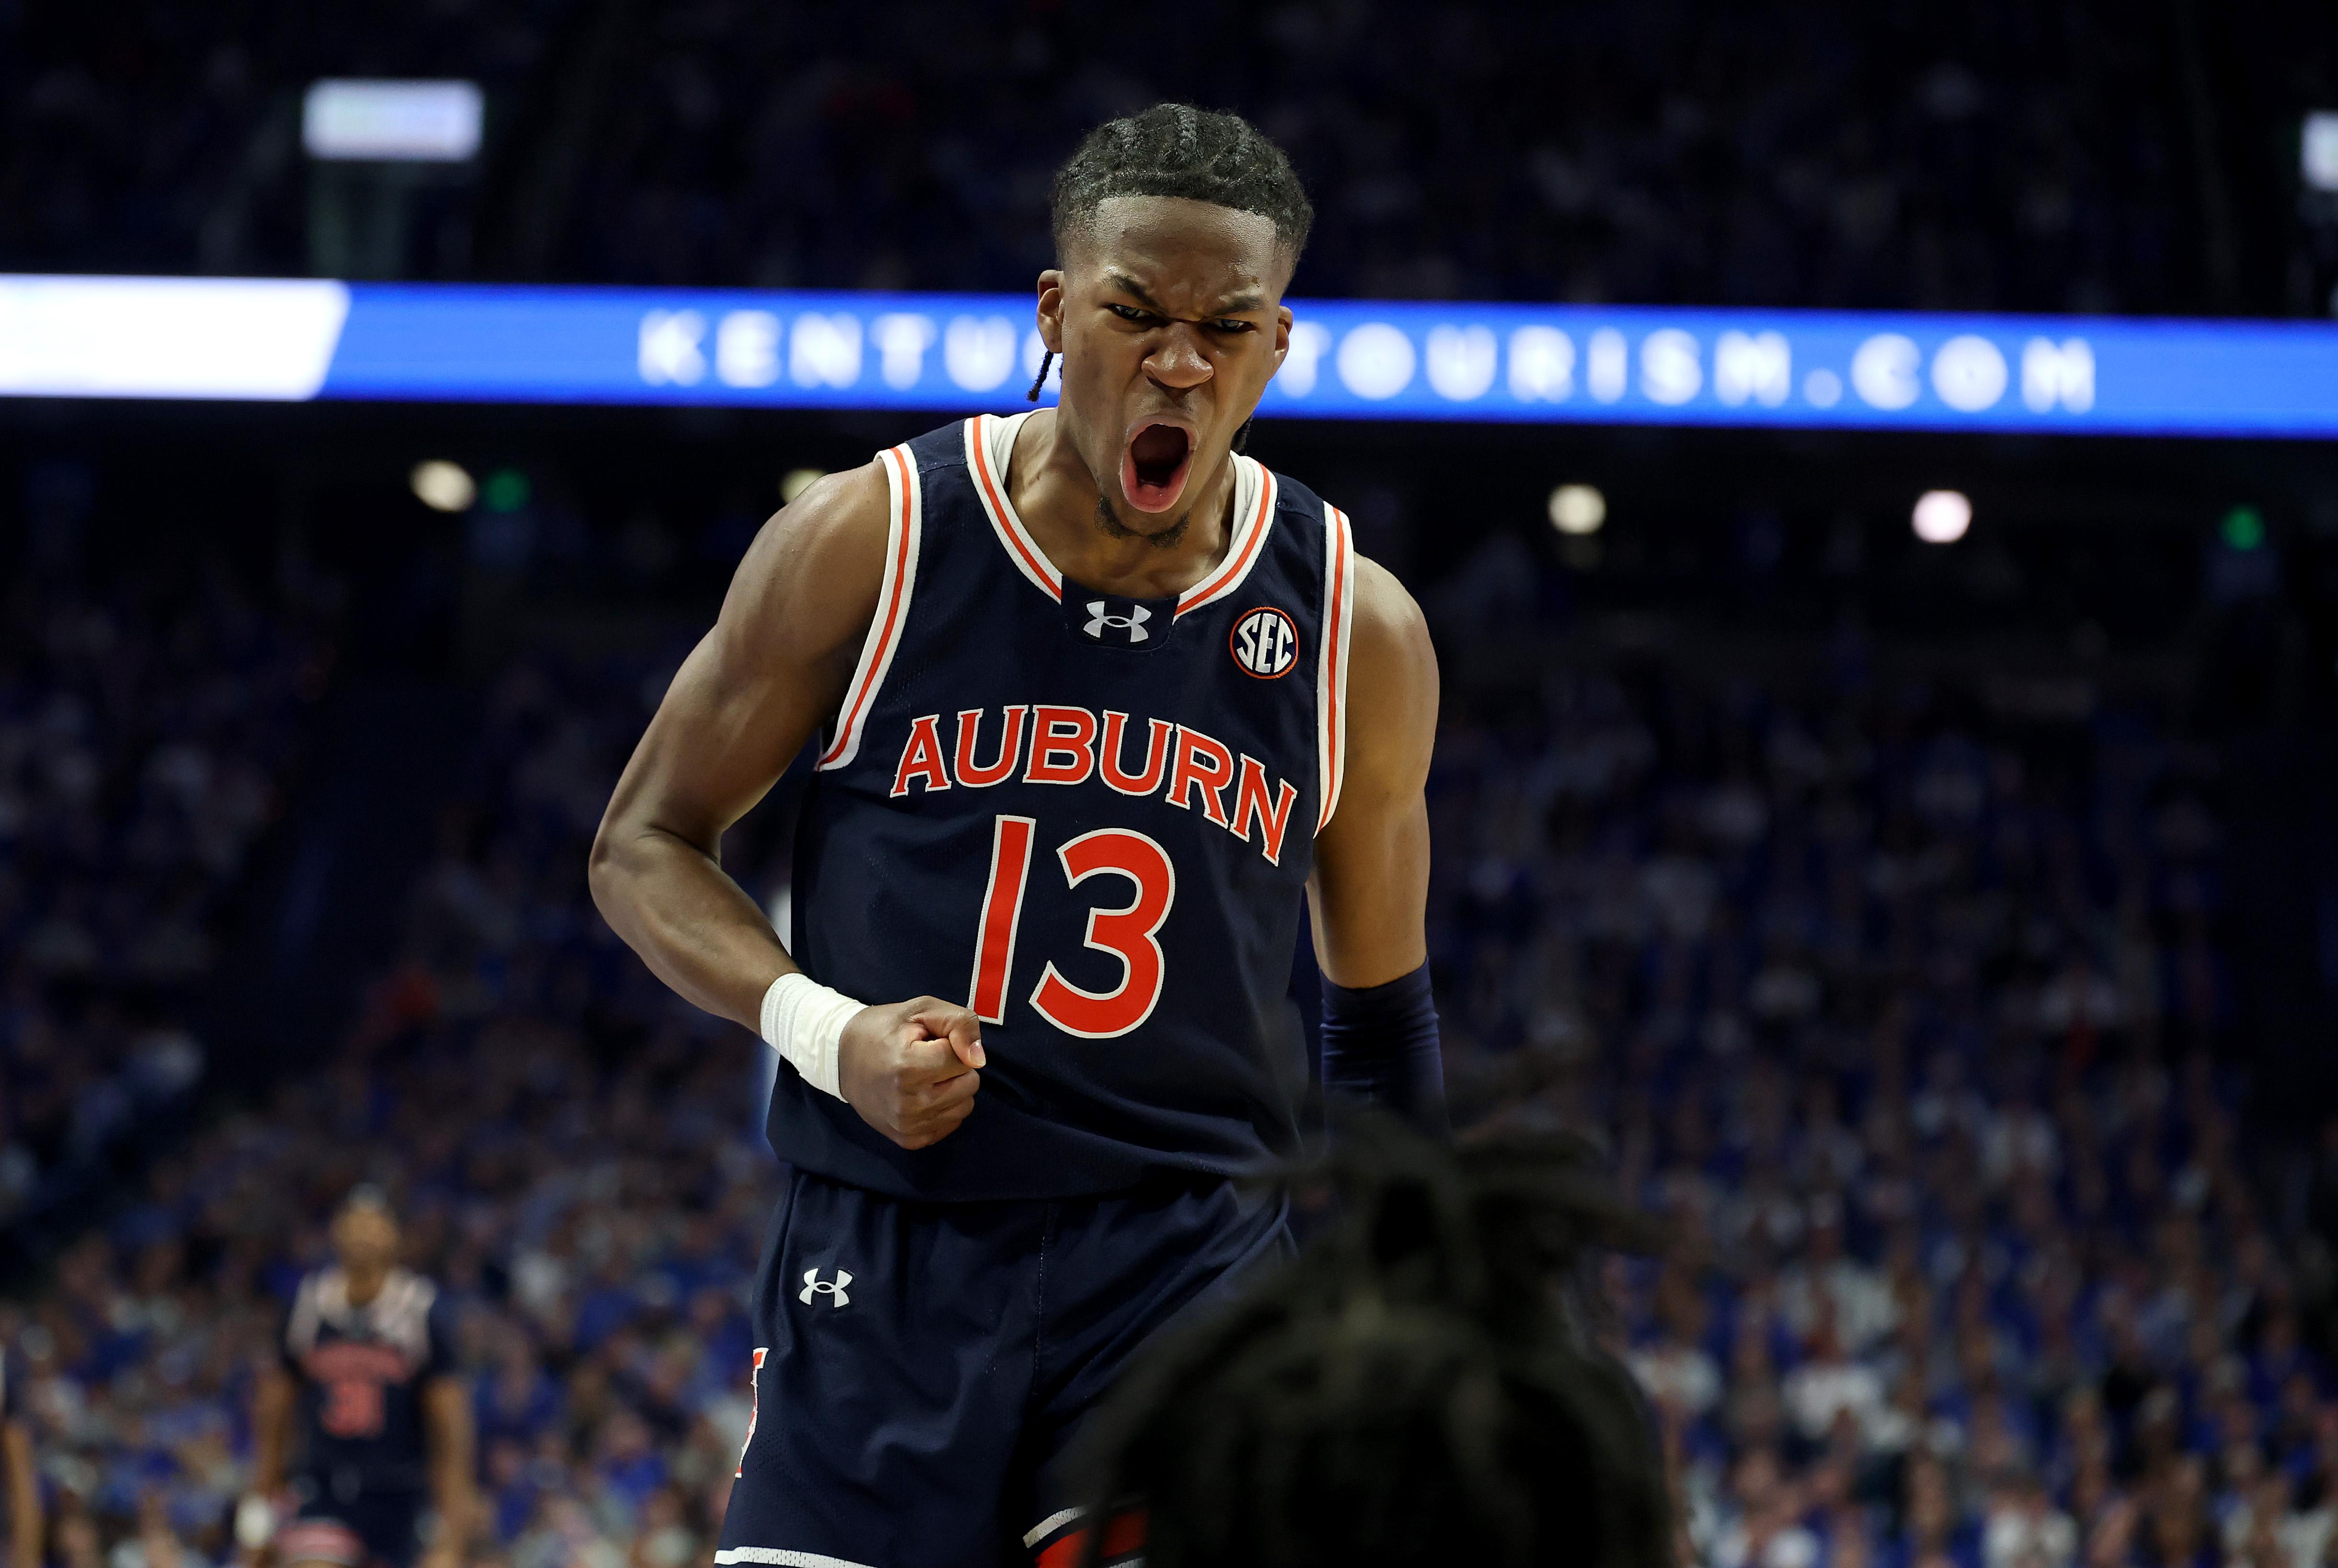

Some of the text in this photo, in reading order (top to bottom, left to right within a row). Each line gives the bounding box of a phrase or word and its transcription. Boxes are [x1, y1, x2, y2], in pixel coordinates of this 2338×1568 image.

[1236, 613, 1294, 674] SEC
[890, 705, 1298, 867] AUBURN
[968, 814, 1176, 1039] 13
